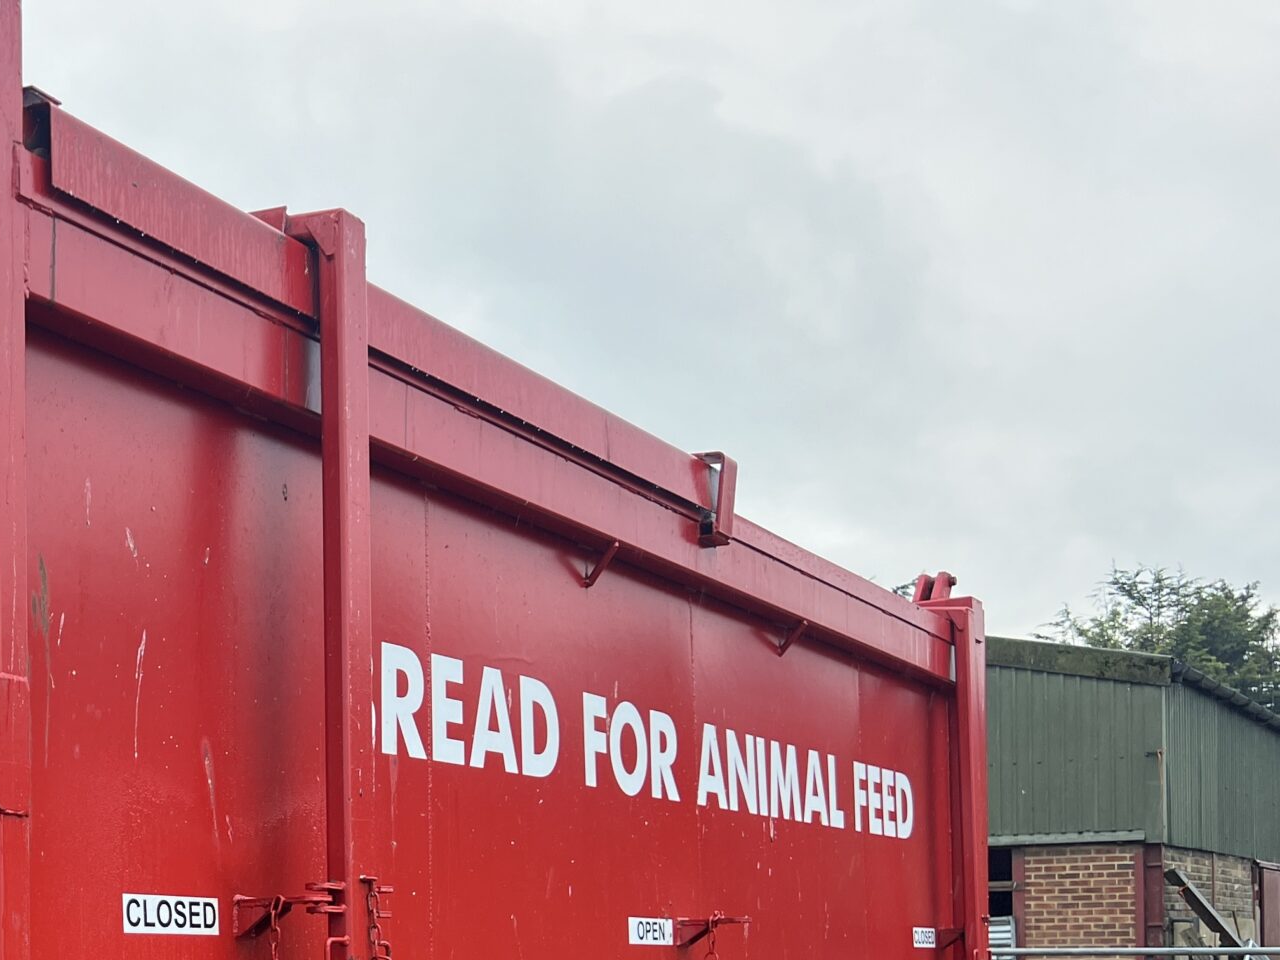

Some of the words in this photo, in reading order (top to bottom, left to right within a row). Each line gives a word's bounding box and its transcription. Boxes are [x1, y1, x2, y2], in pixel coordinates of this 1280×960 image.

[371, 642, 561, 779] READ
[582, 690, 682, 803] FOR
[696, 722, 846, 830] ANIMAL
[852, 759, 915, 840] FEED
[125, 897, 217, 930] CLOSED
[637, 920, 666, 942] OPEN
[914, 929, 935, 945] CLOSED
